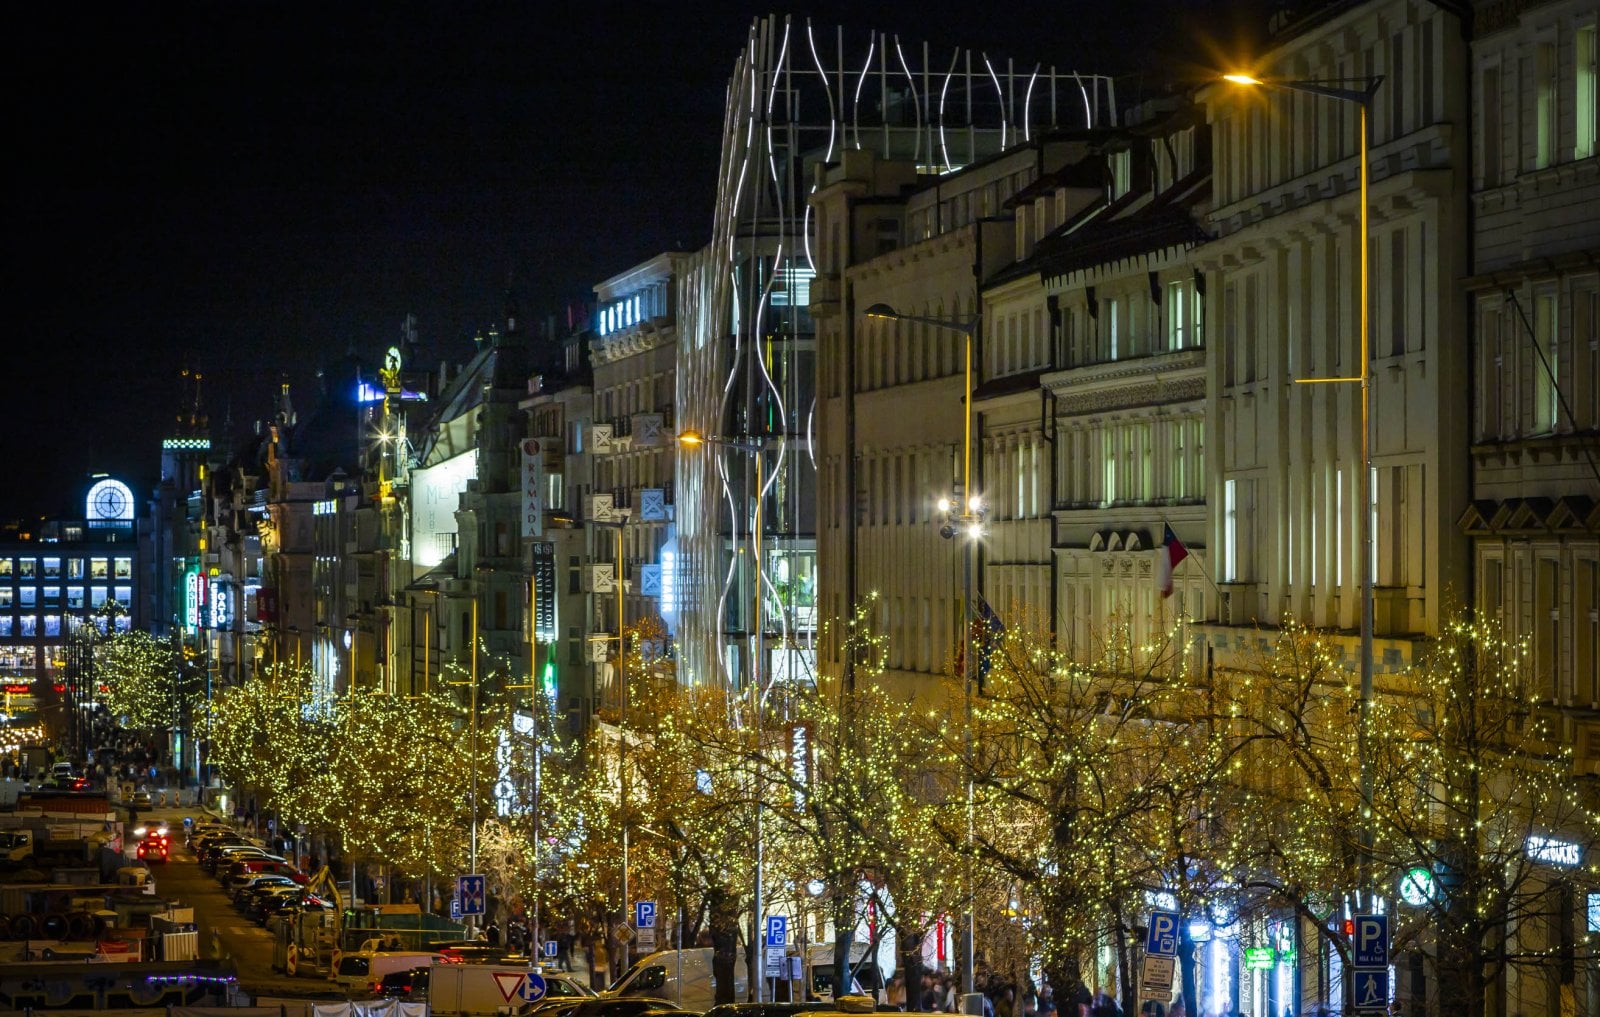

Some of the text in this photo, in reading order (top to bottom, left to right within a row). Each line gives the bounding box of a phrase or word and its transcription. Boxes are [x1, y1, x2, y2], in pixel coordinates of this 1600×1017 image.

[527, 463, 537, 536] RAMADA
[662, 552, 674, 612] PRIMARK
[1527, 836, 1579, 865] STARBUCKS
[641, 905, 652, 920] P
[770, 919, 783, 937] P
[1154, 916, 1173, 942] P
[1361, 921, 1381, 952] P
